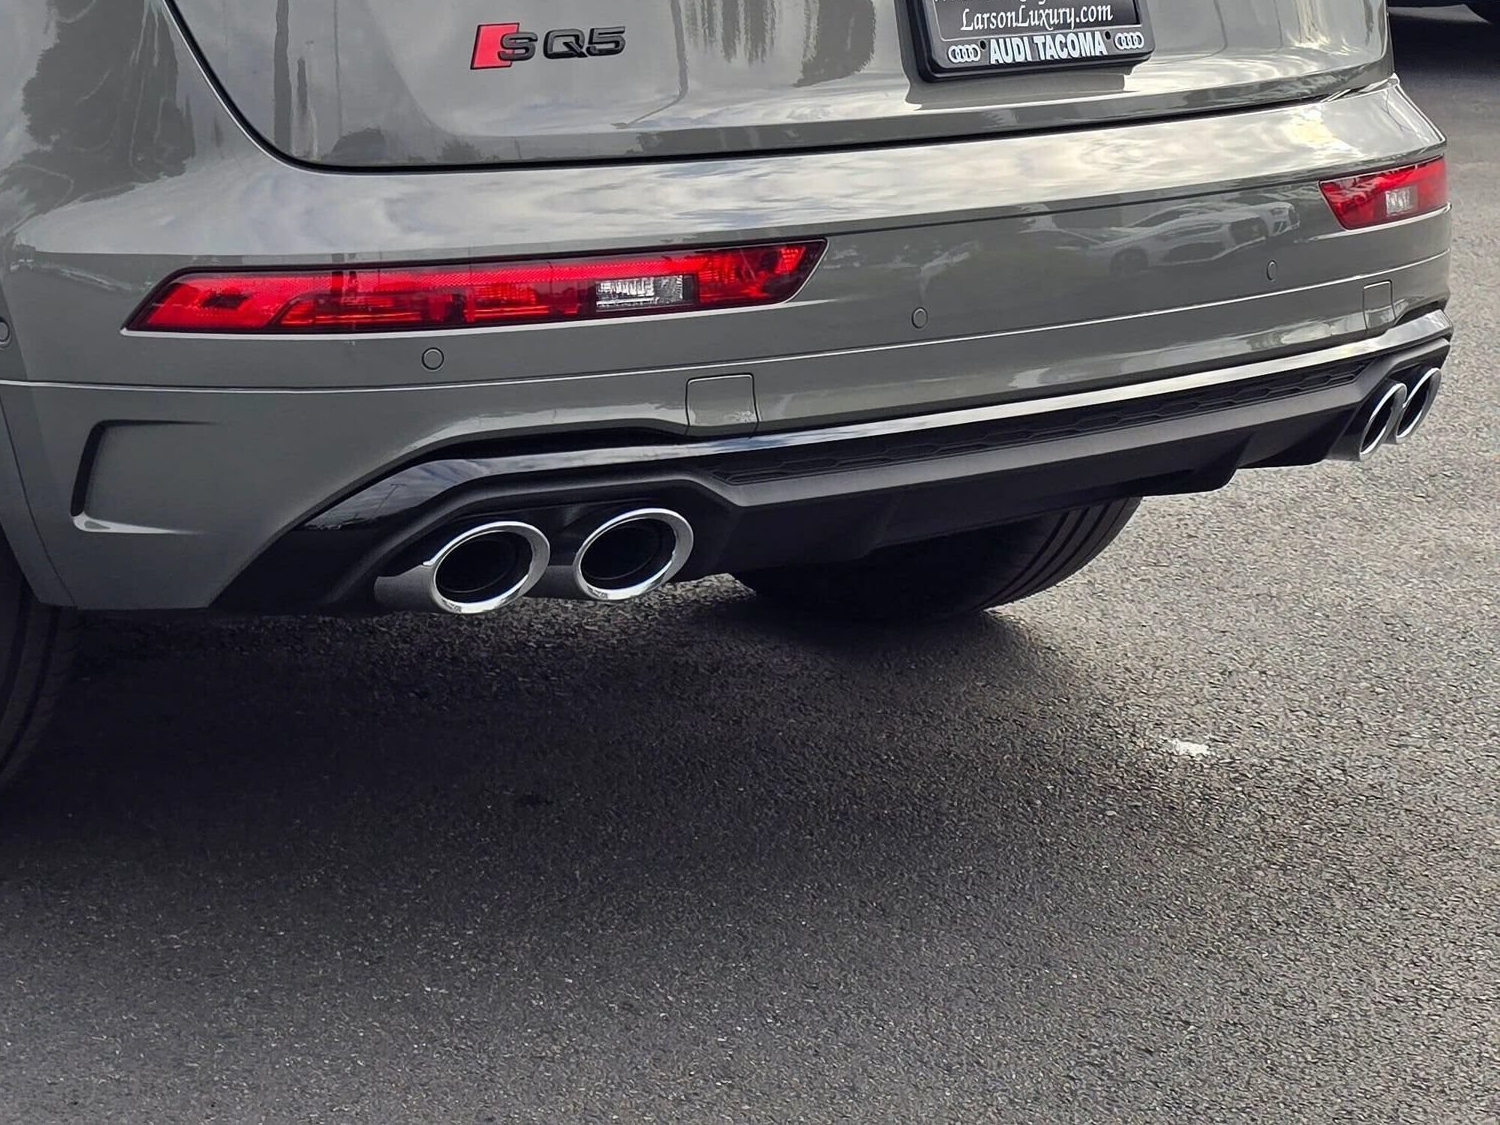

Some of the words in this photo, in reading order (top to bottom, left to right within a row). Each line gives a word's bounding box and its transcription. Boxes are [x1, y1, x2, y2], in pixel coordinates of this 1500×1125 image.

[960, 4, 1114, 31] LarsonLuxury.com
[989, 38, 1032, 64] AUDI
[1036, 31, 1109, 60] TACOMA
